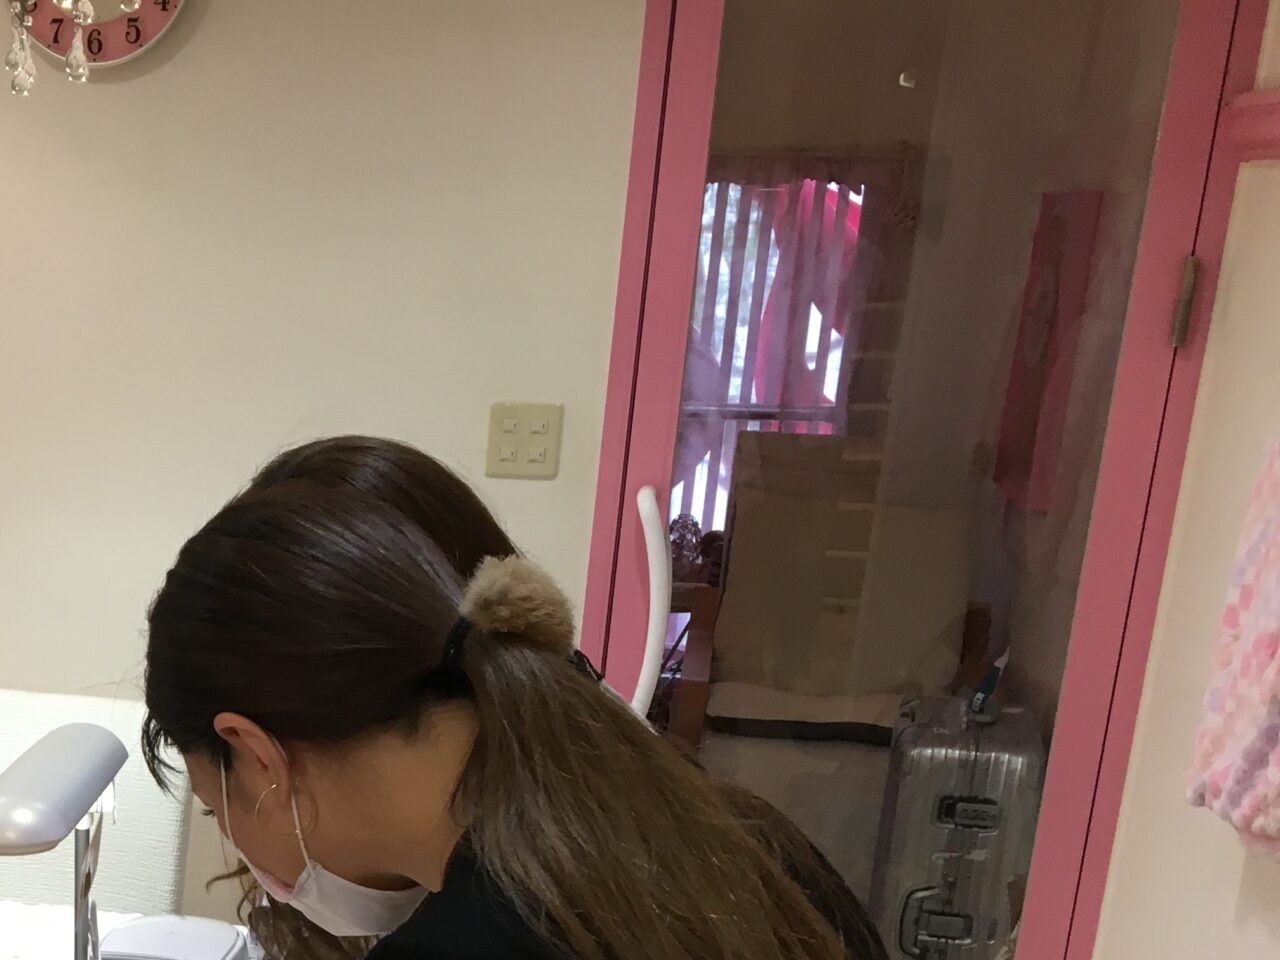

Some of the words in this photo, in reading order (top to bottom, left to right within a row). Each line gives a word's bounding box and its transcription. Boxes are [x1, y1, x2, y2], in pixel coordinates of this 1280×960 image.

[50, 18, 64, 43] 7
[87, 28, 102, 55] 6
[125, 16, 141, 44] 5
